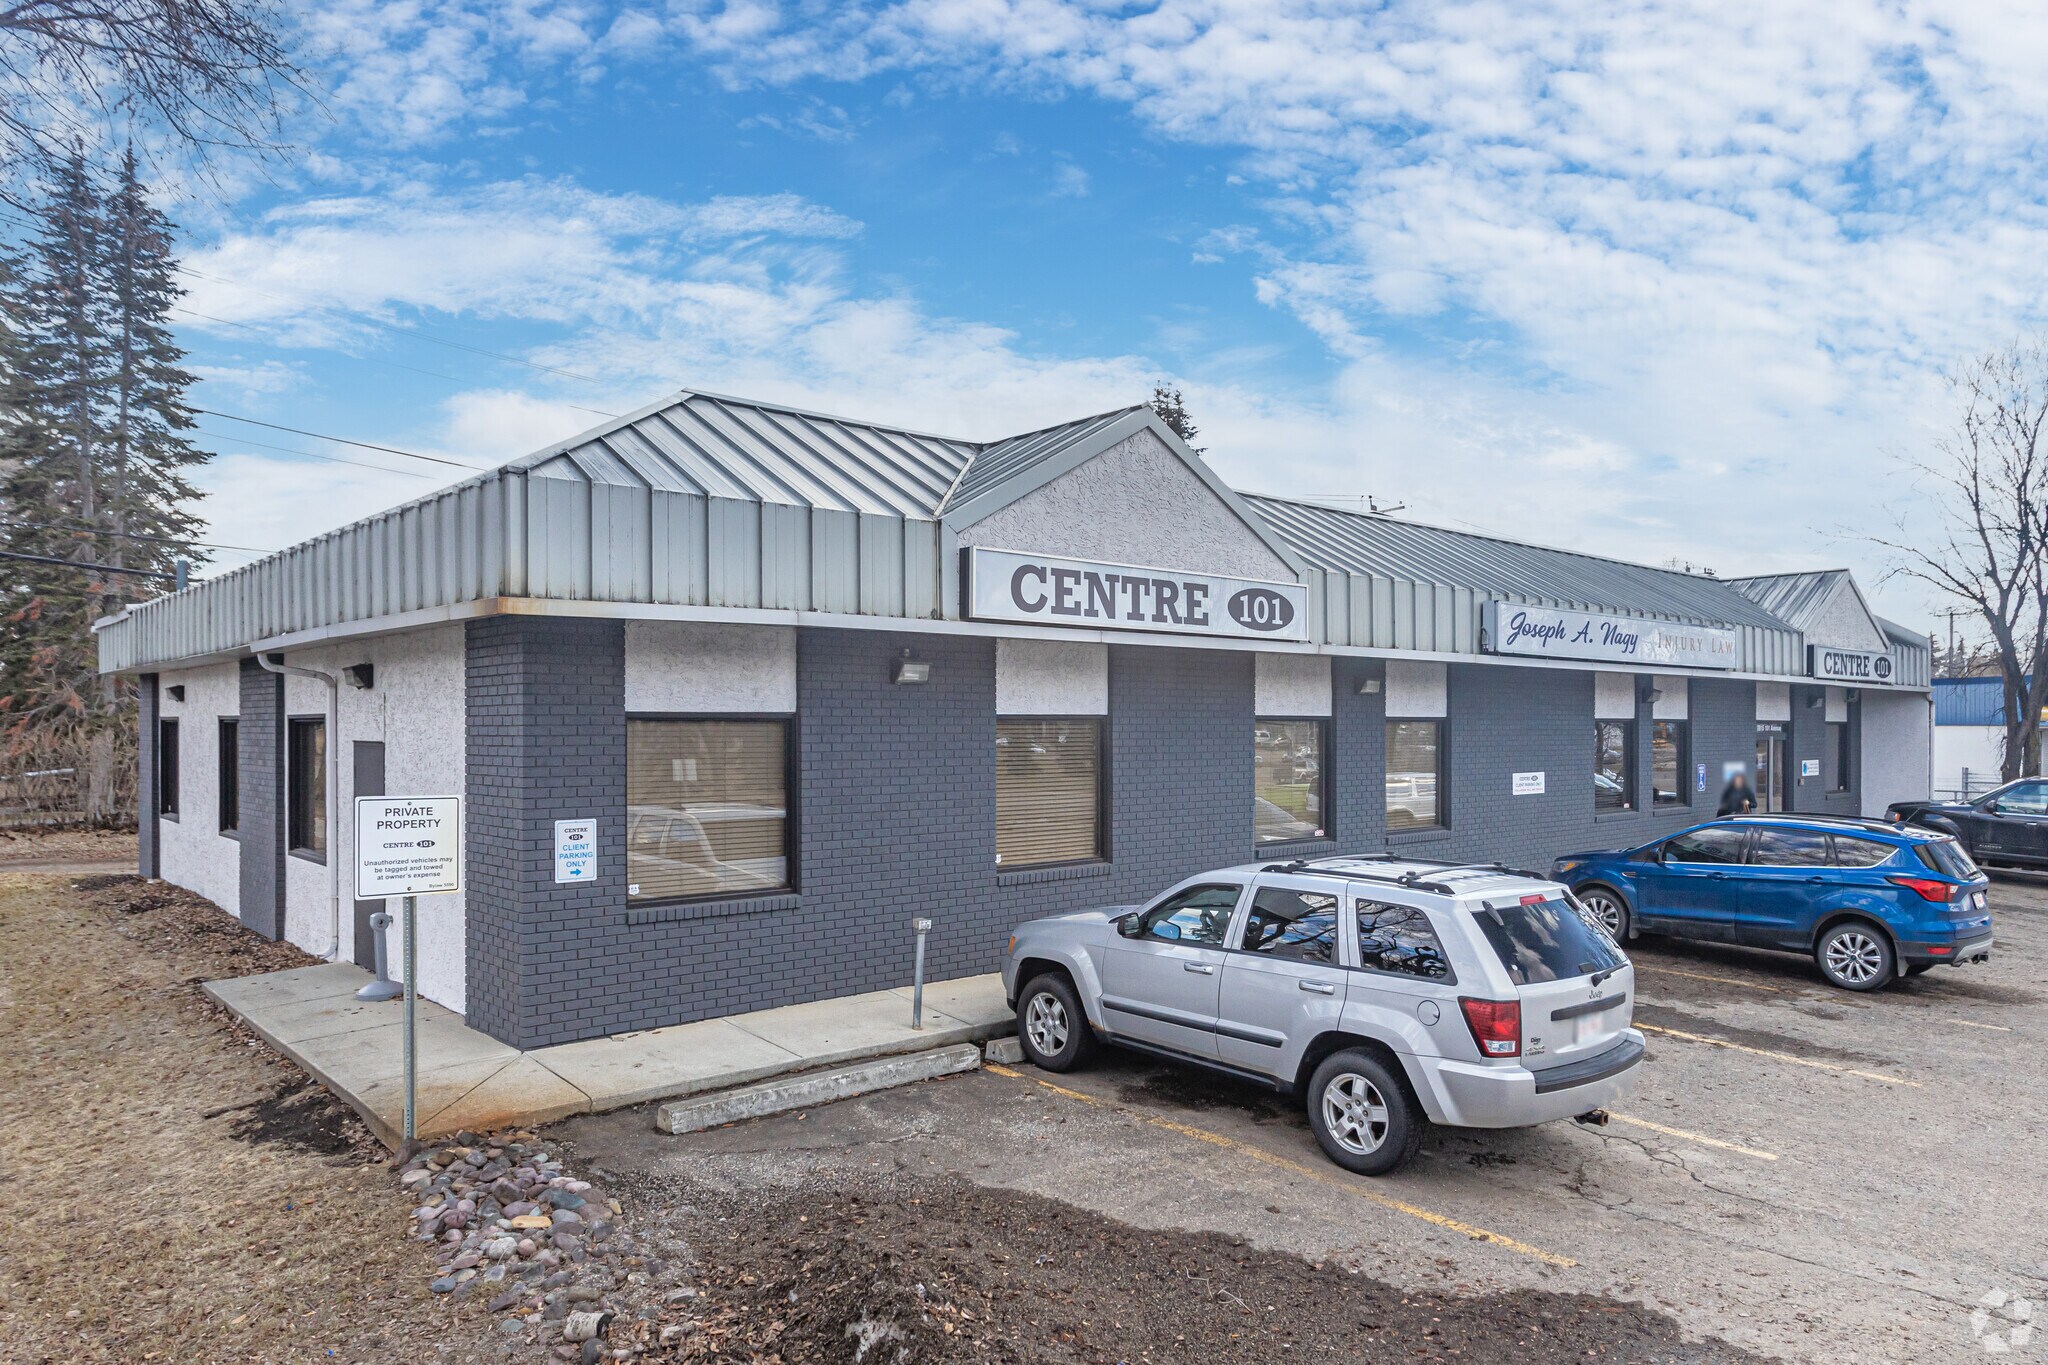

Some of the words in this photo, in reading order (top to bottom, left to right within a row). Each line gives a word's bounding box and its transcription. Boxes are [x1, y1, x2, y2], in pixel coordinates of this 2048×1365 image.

[1010, 564, 1209, 627] CENTRE
[1239, 594, 1284, 625] 101
[1506, 611, 1567, 648] Joseph
[1570, 621, 1594, 644] A.
[1600, 621, 1639, 654] Nagy
[1658, 632, 1703, 652] INJURY
[1711, 638, 1733, 654] LAW
[1824, 652, 1870, 677] CENTRE
[1876, 660, 1889, 675] 101
[385, 807, 433, 817] PRIVATE
[377, 819, 441, 830] PROPERTY
[383, 841, 414, 849] CENTRE
[562, 843, 590, 851] CLIENT
[559, 851, 593, 860] PARKING
[364, 858, 409, 867] Unauthorized
[566, 860, 587, 868] ONLY
